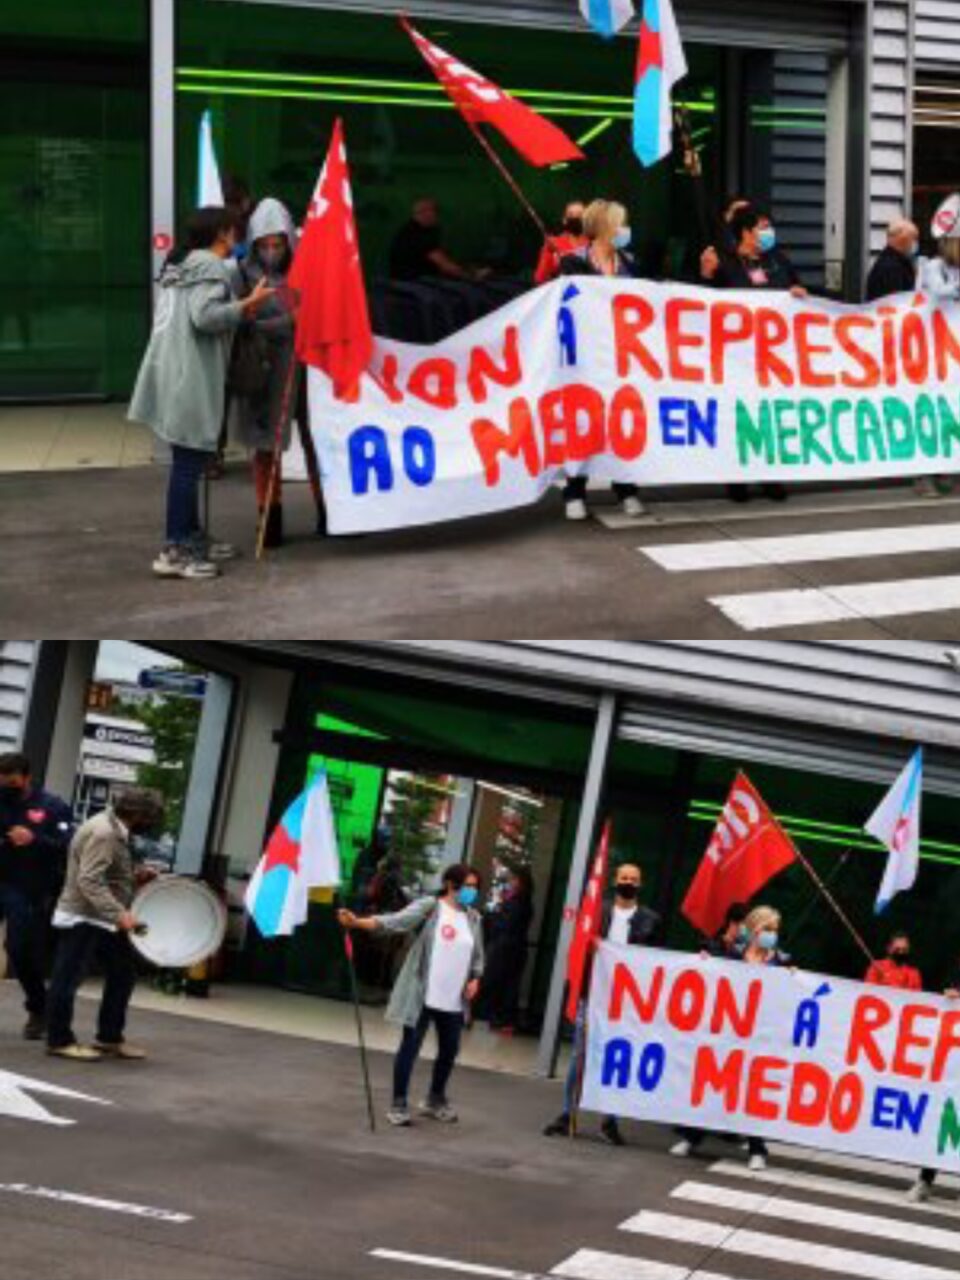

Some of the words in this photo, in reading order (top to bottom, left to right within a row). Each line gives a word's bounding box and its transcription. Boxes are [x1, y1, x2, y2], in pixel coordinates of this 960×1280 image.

[347, 425, 437, 495] AO
[471, 383, 647, 487] MEDO
[658, 397, 718, 447] EN
[608, 962, 762, 1039] NON
[600, 1036, 666, 1093] AO
[690, 1046, 864, 1133] MEDO
[870, 1086, 929, 1134] EN
